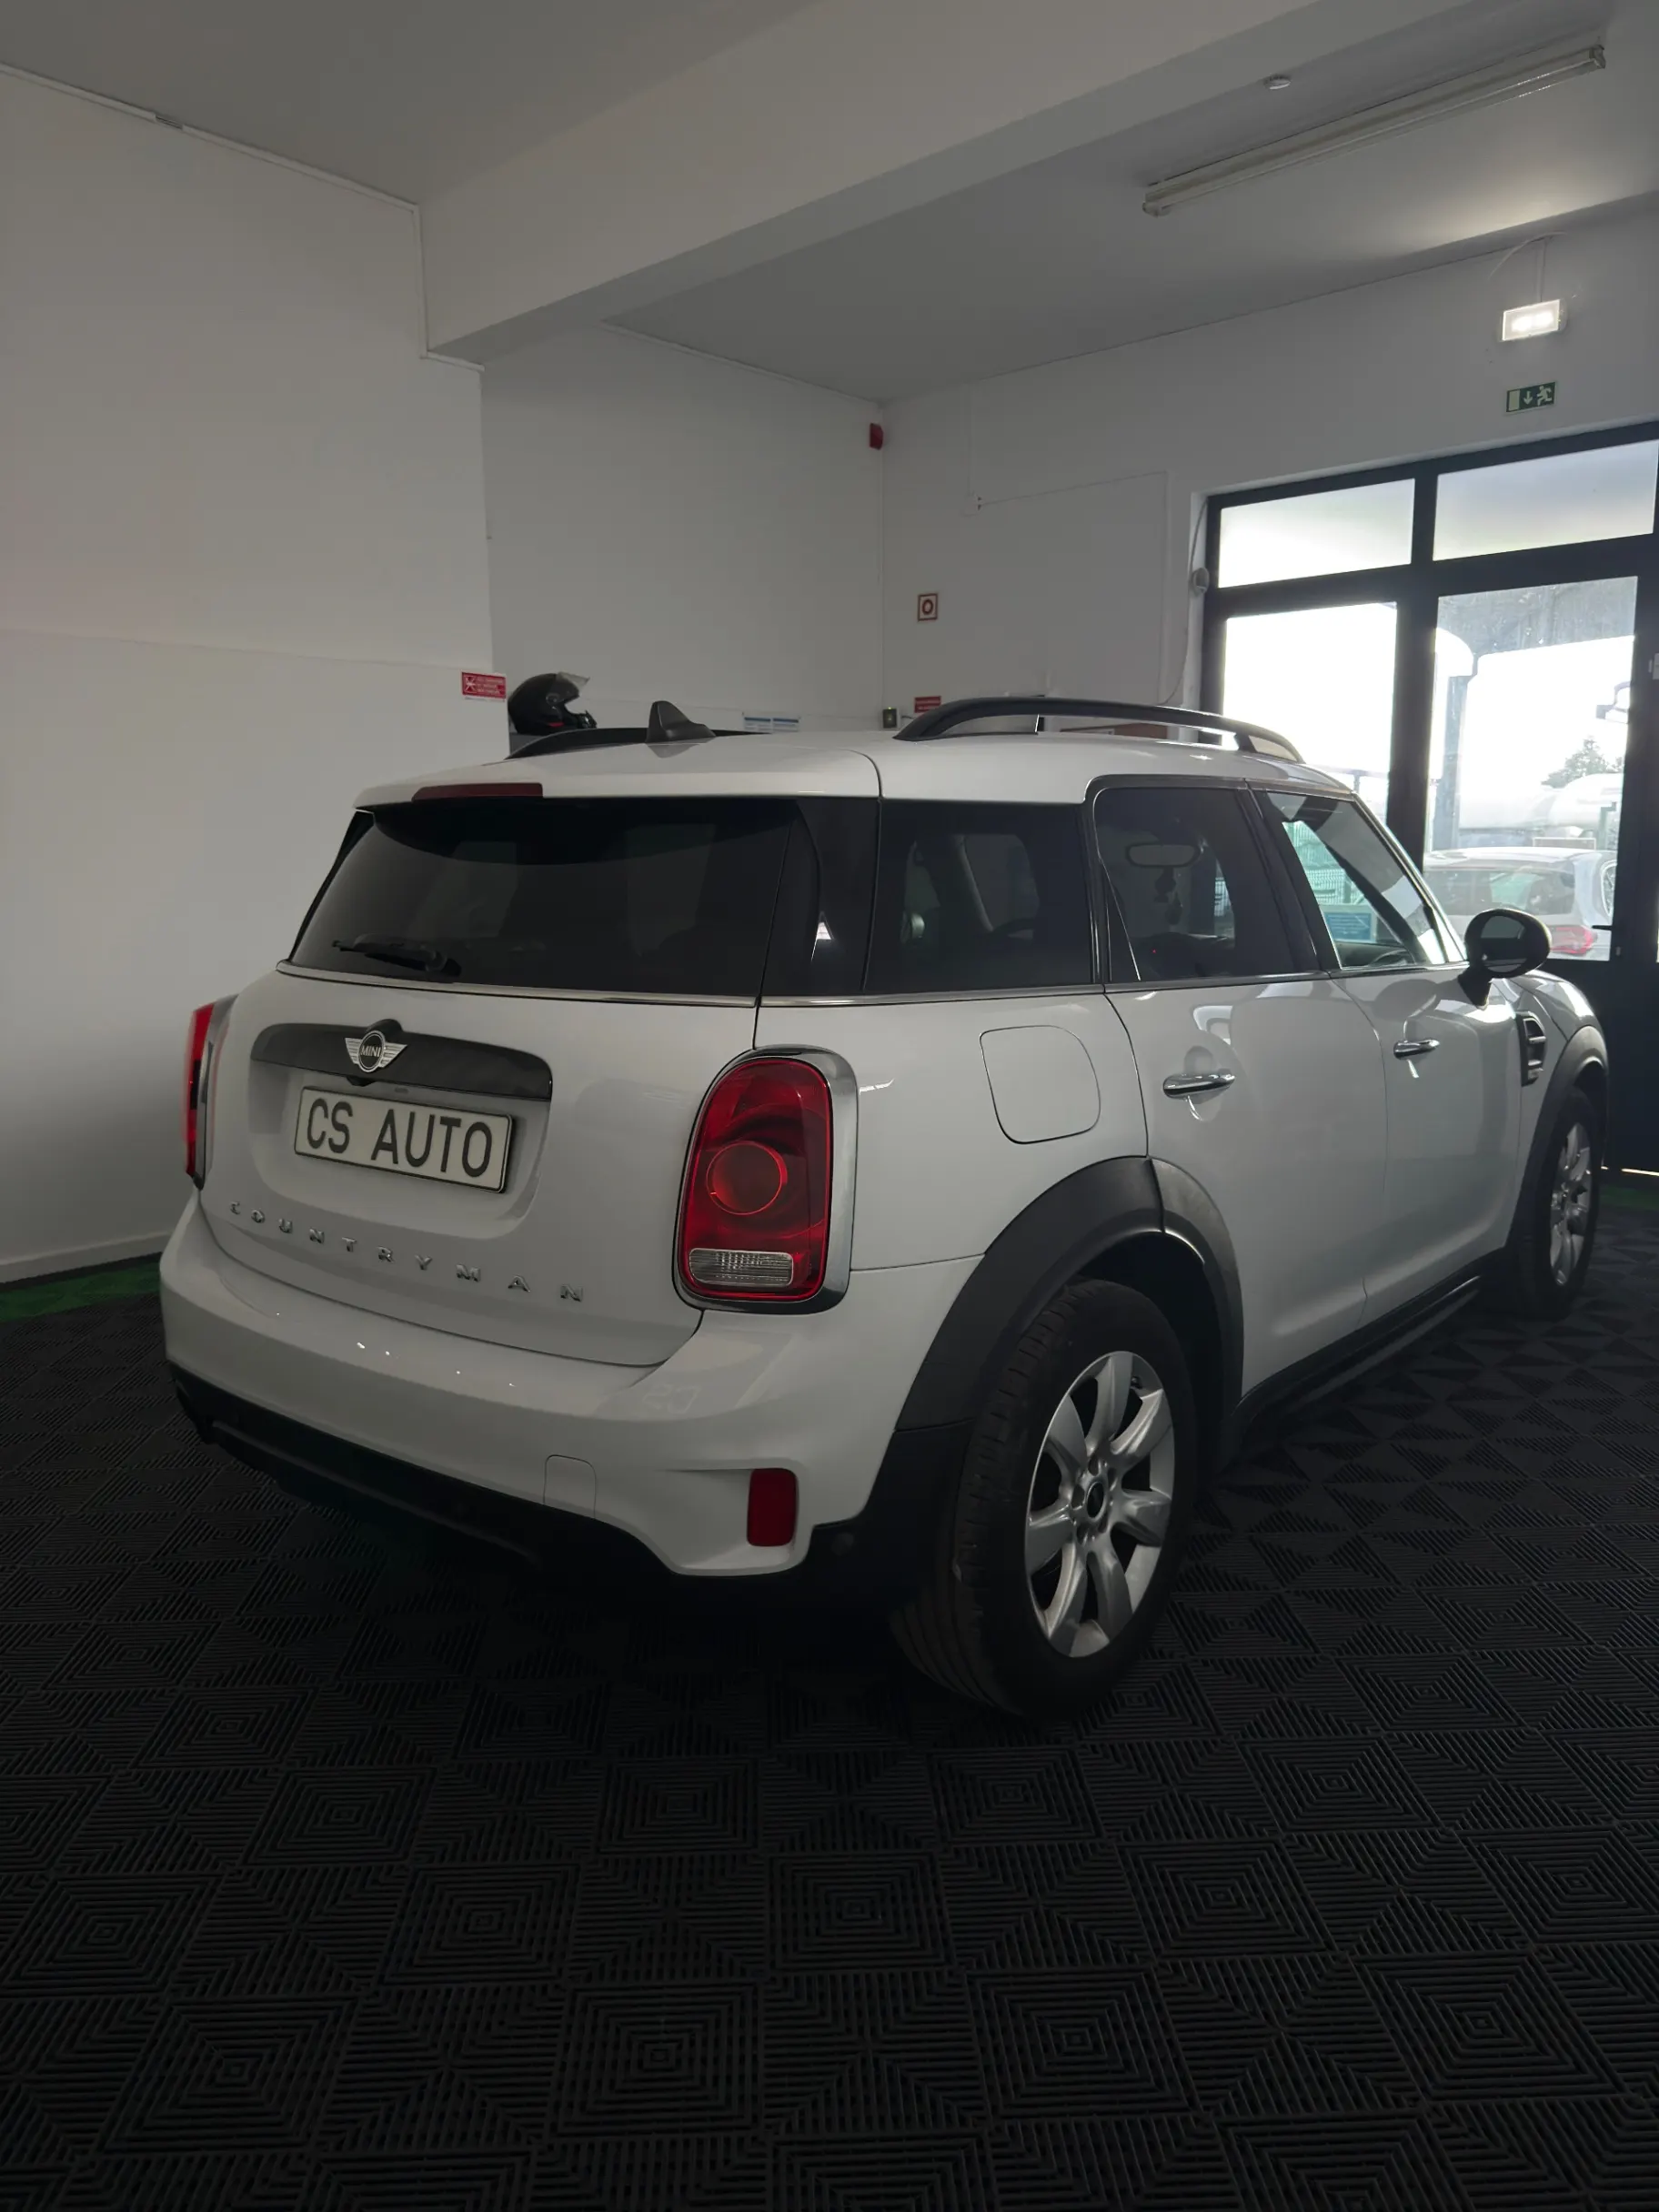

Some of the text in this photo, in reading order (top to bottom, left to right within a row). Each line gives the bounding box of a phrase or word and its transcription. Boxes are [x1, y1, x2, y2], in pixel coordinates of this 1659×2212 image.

[360, 1044, 381, 1058] MINI
[307, 1098, 493, 1178] CS AUTO
[229, 1201, 583, 1302] COUNTRYMAN
